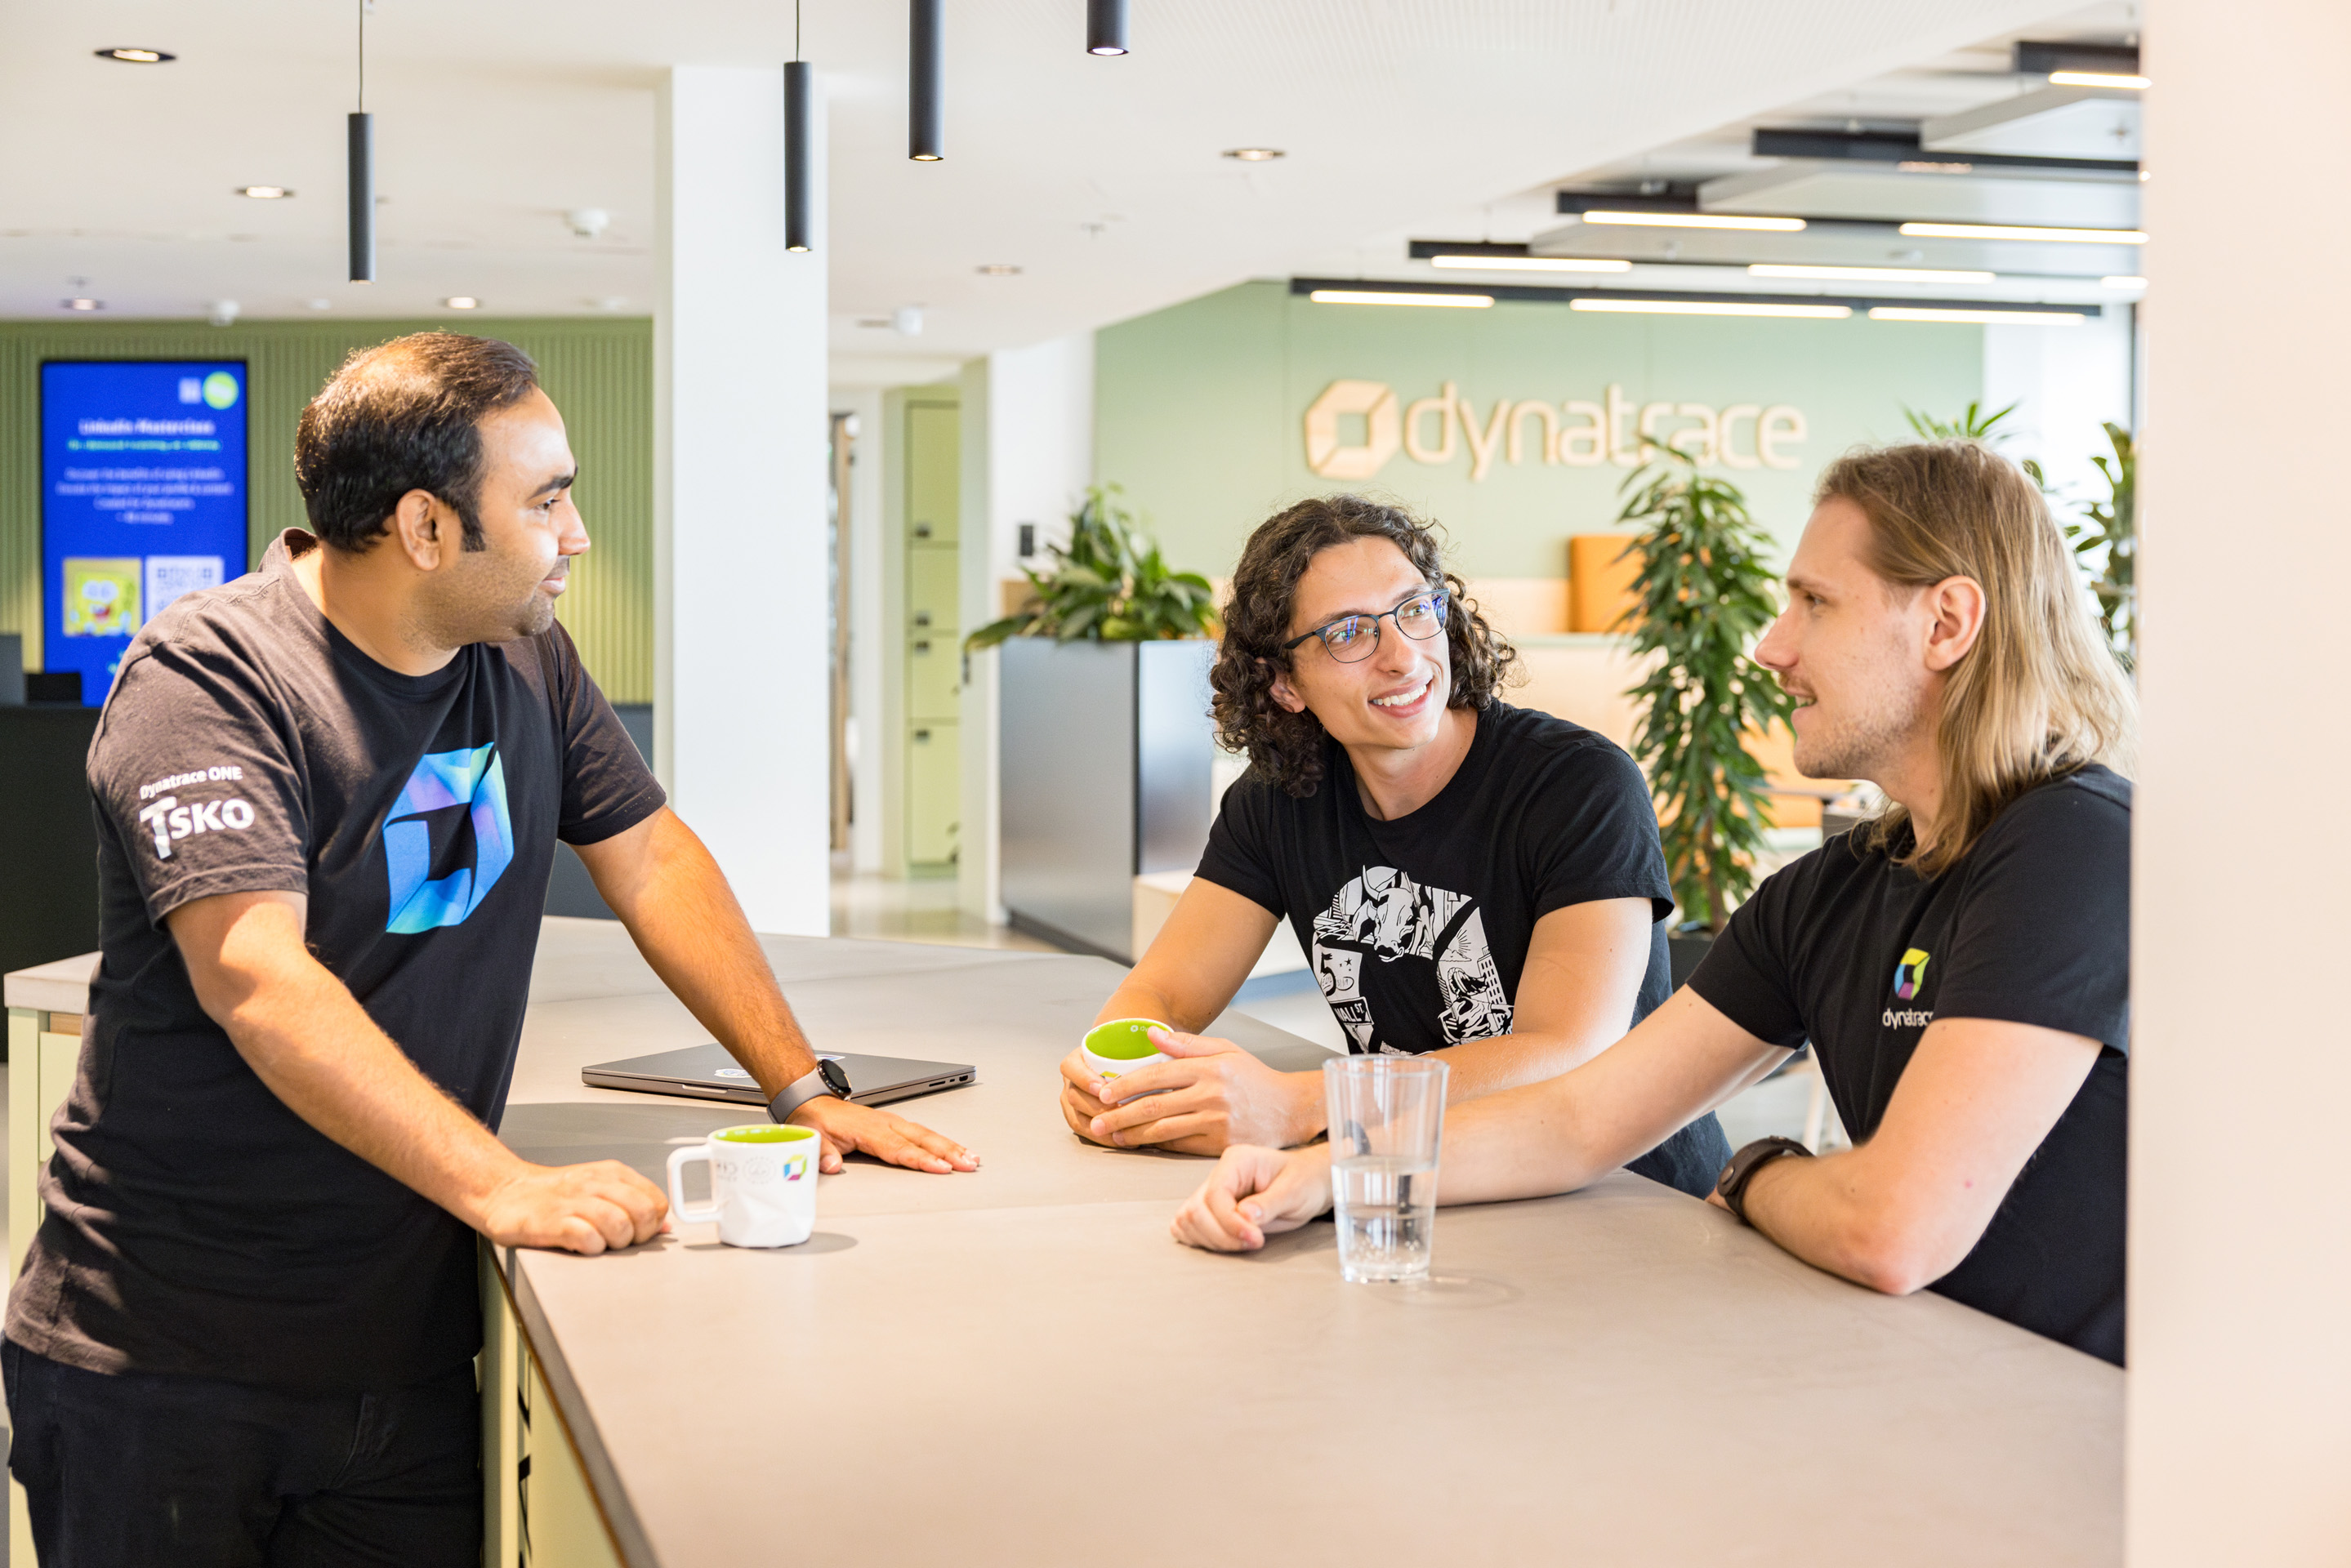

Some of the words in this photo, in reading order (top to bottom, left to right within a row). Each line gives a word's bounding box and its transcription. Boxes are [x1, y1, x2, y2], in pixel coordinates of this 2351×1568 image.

[1403, 379, 1809, 483] dynatrace
[140, 770, 207, 800] Dynatrace
[207, 766, 243, 781] ONE
